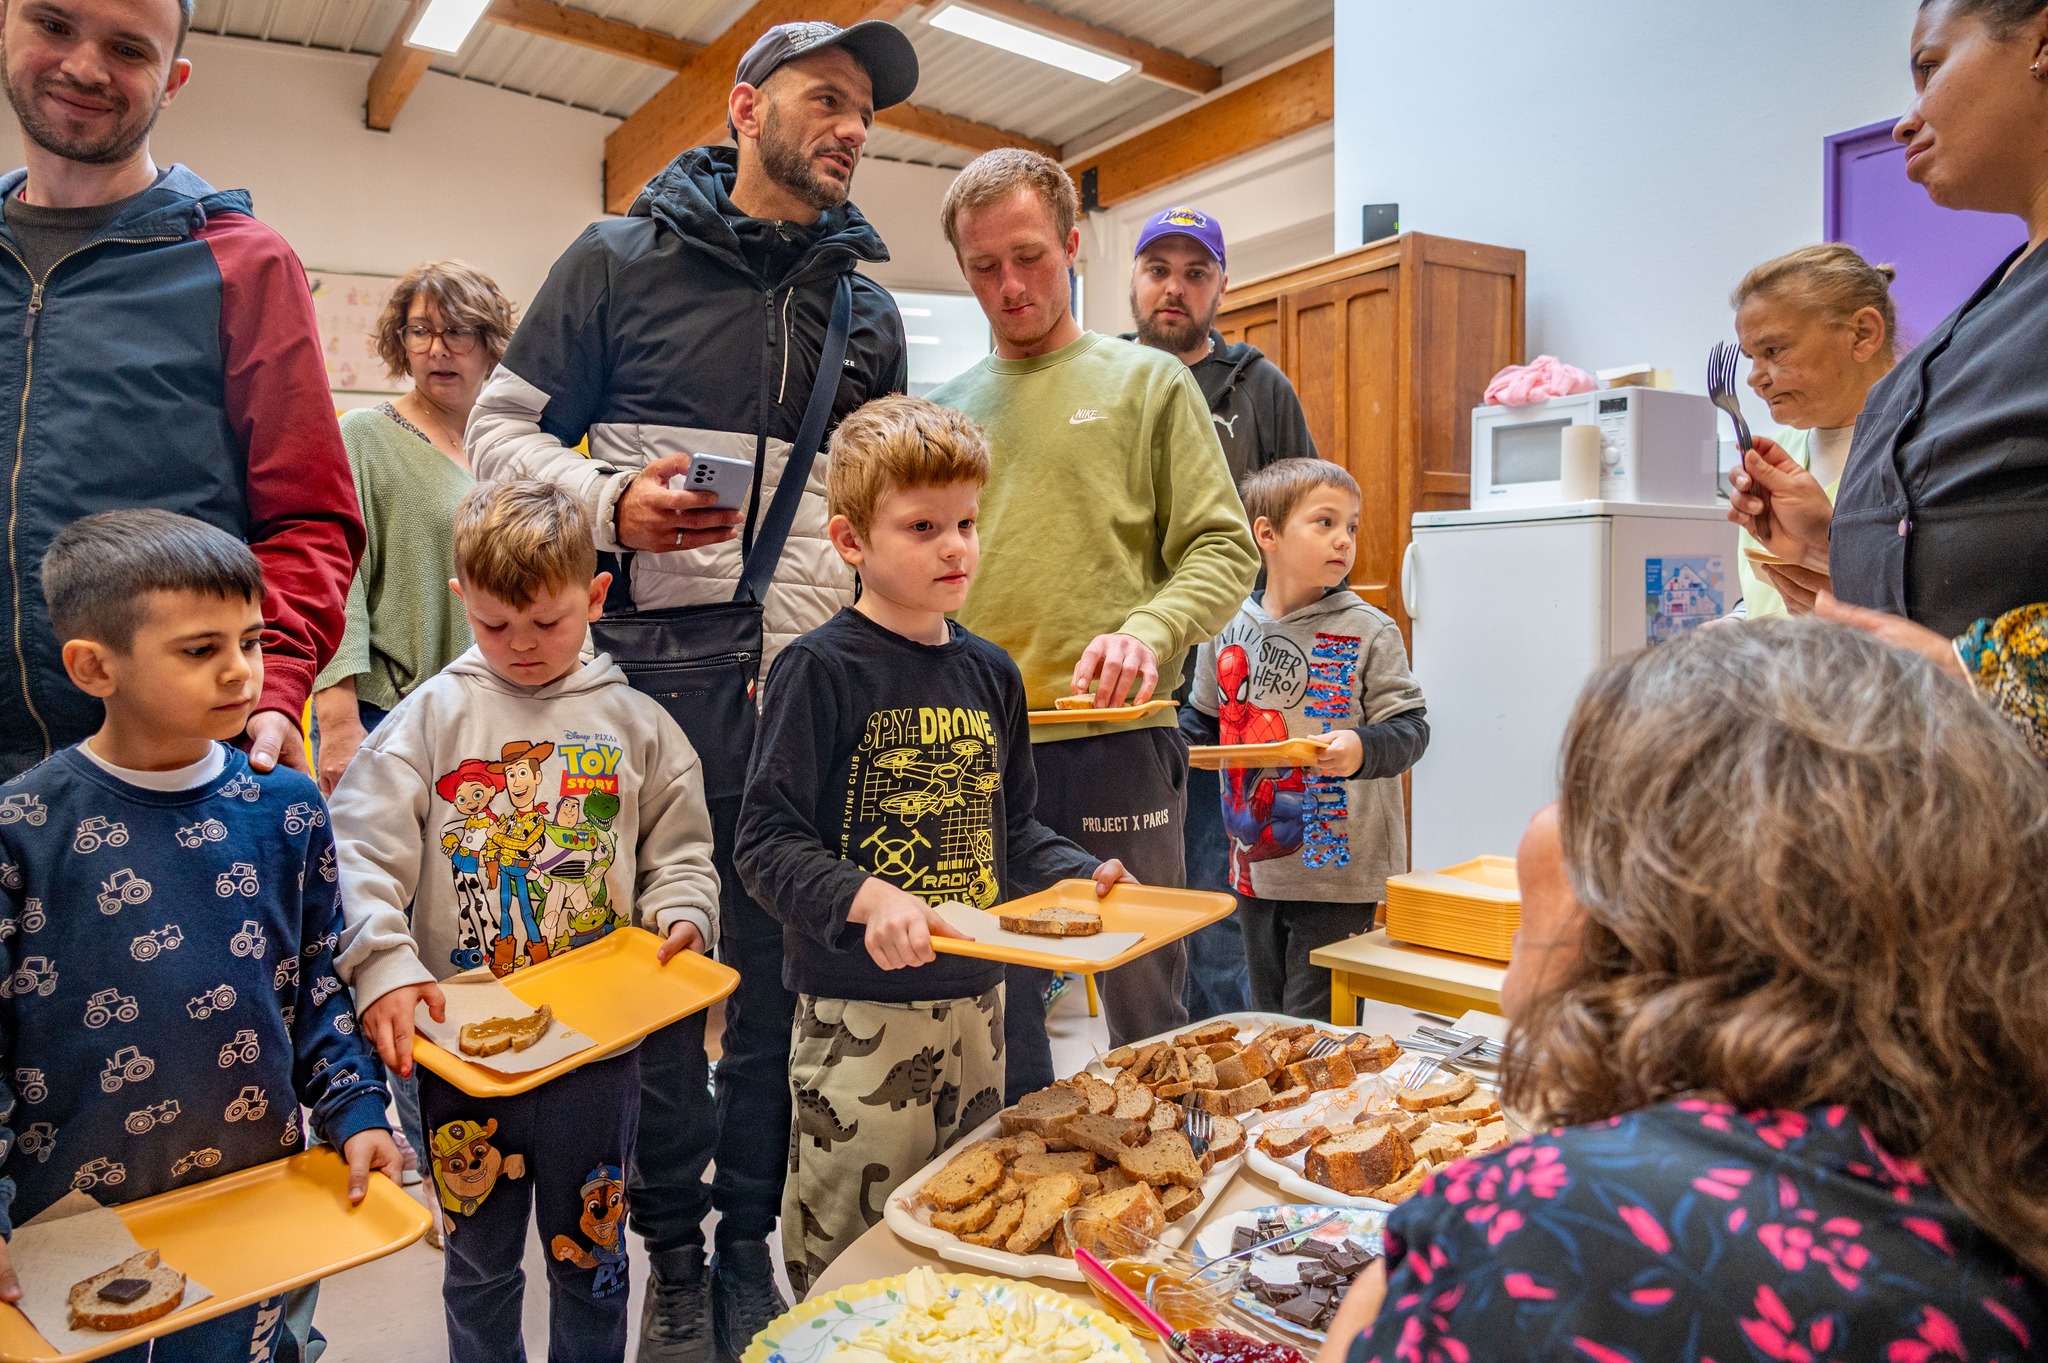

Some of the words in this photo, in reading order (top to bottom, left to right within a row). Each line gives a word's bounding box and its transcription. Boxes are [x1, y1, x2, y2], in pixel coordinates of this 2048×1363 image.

[1075, 409, 1098, 418] NIKE
[1259, 641, 1302, 678] SUPER
[1253, 665, 1300, 703] HERO!
[858, 708, 912, 751] SPY
[919, 707, 995, 745] DRONE
[558, 743, 623, 778] TOY
[848, 755, 860, 785] CLUB
[567, 777, 614, 790] STORY
[843, 789, 855, 829] FLYING
[1082, 816, 1128, 833] PROJECT
[1132, 815, 1140, 831] X
[1143, 808, 1169, 829] PARIS
